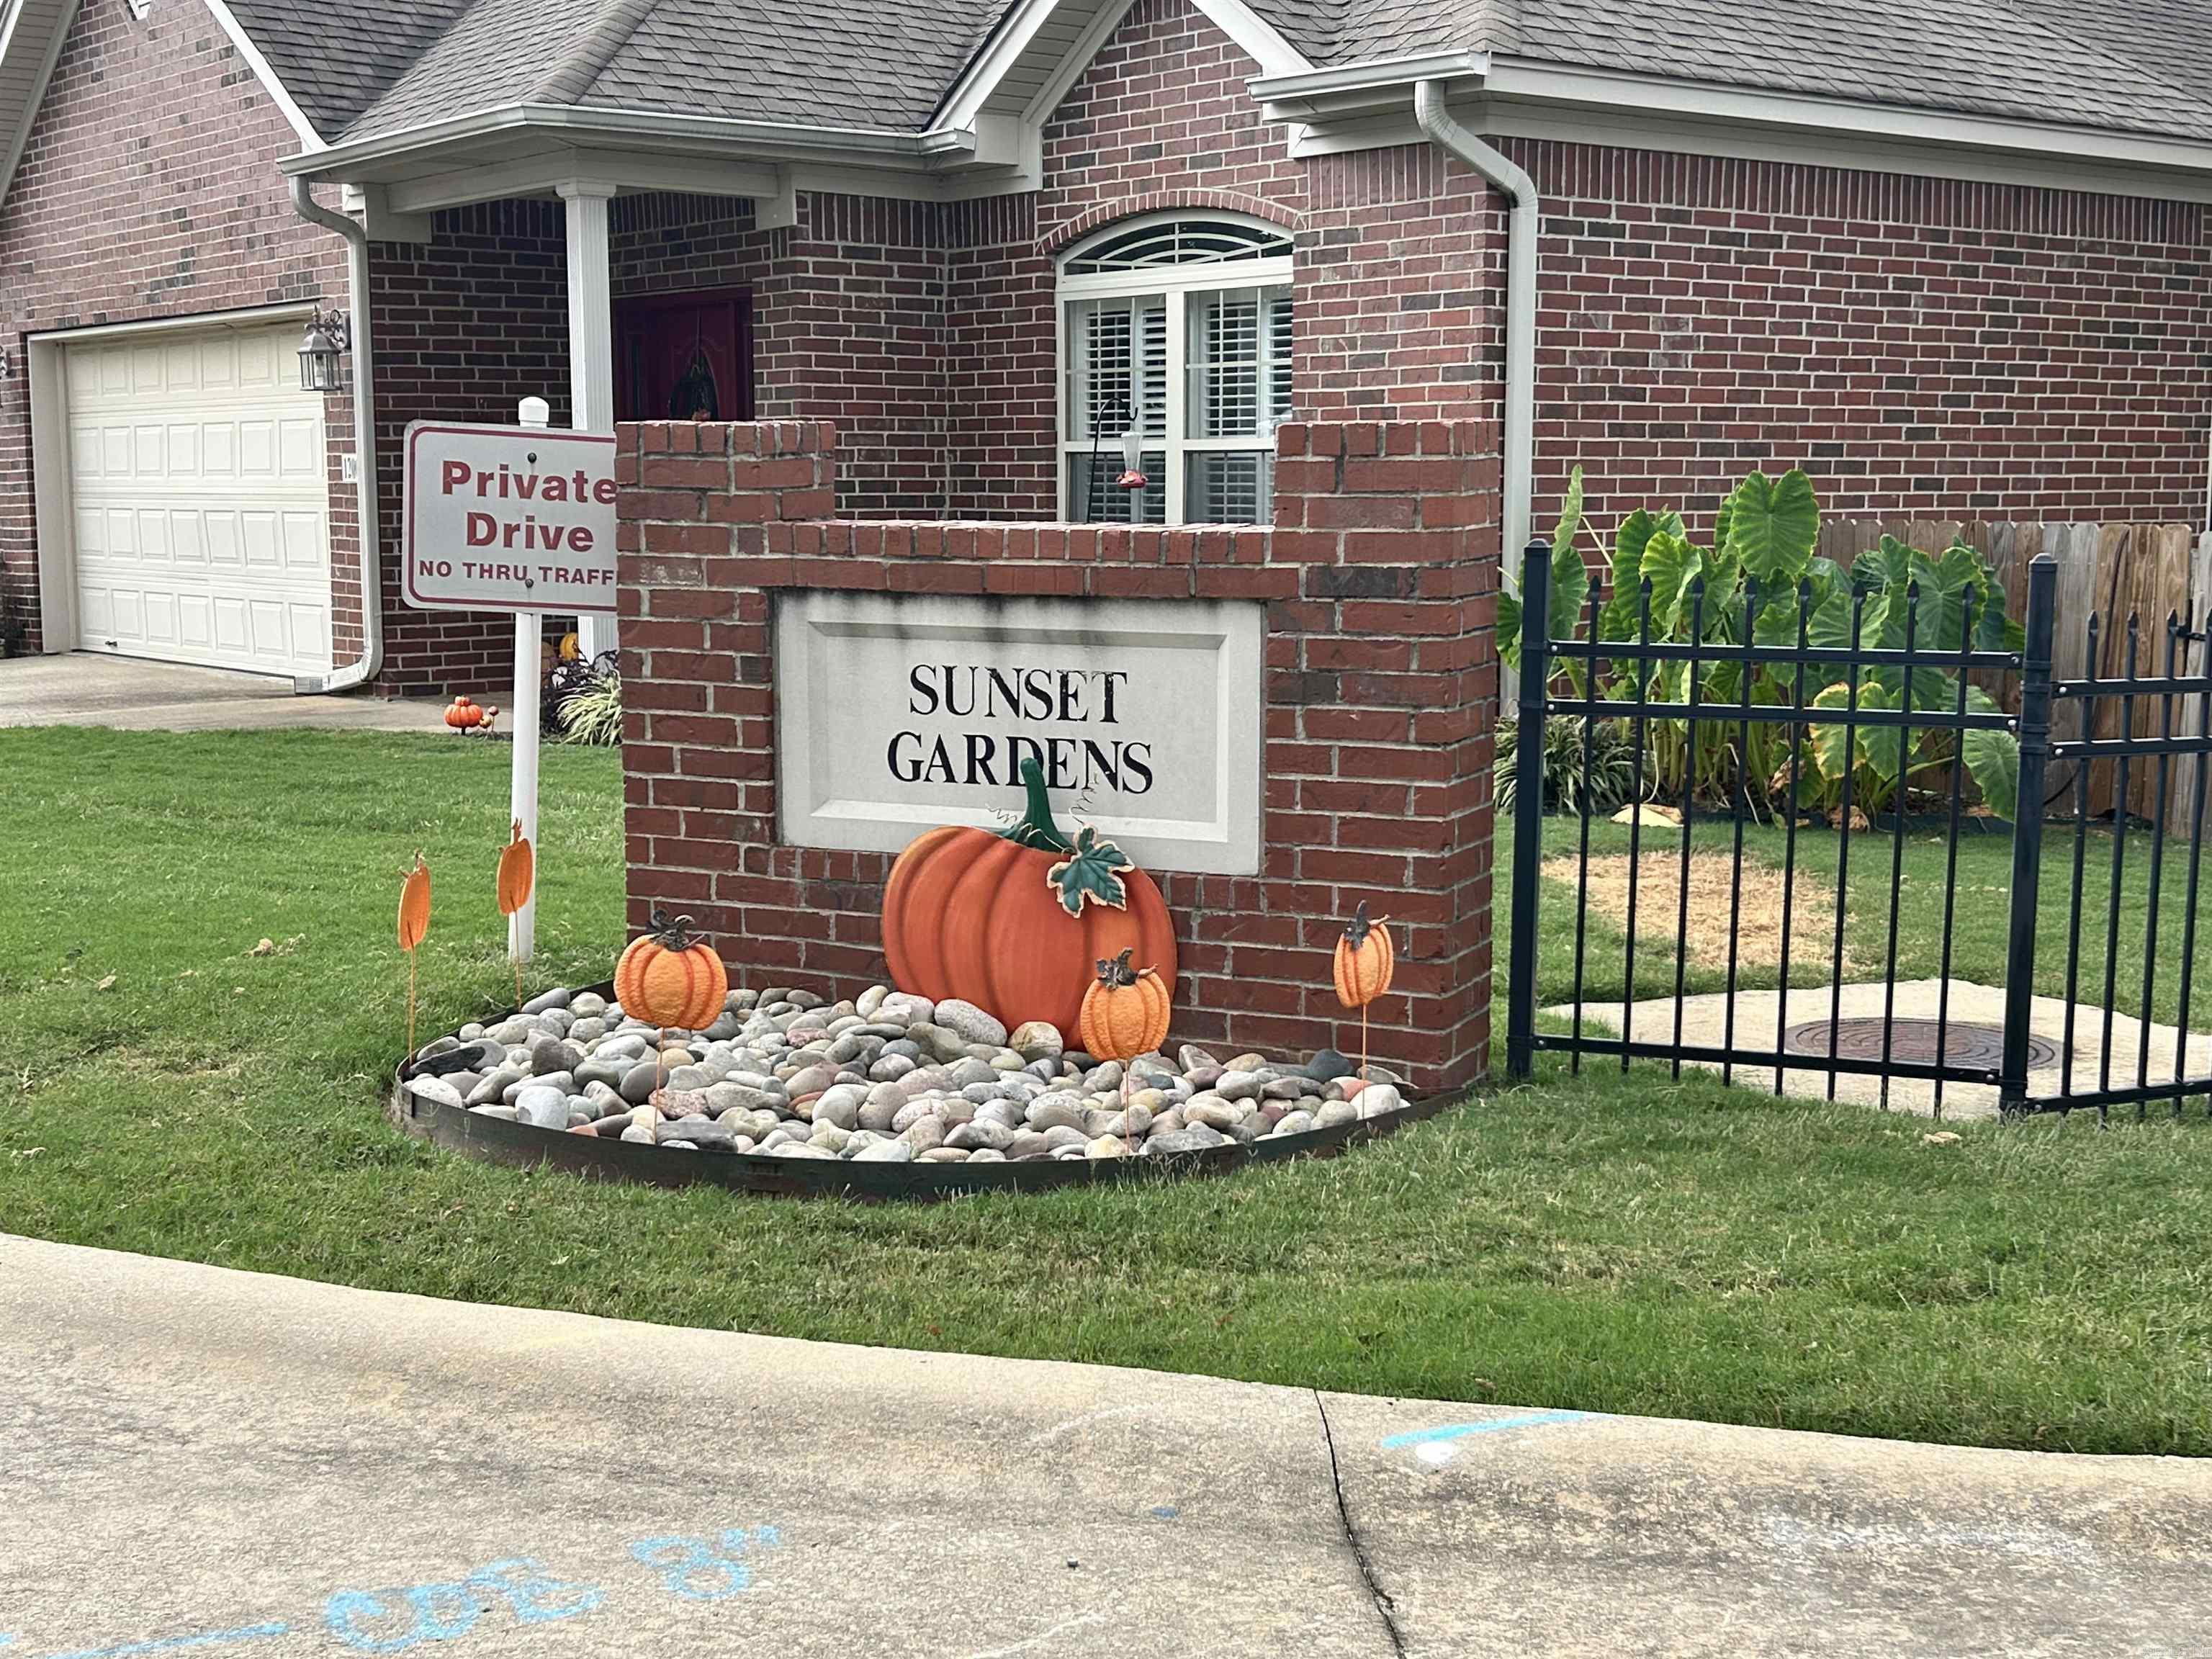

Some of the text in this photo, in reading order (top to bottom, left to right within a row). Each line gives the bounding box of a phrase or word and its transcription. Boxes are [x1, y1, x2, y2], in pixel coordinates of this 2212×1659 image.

[442, 460, 617, 504] Private
[467, 512, 594, 552] Drive
[419, 560, 452, 577] NO
[462, 562, 528, 581] THRU
[910, 664, 1128, 724] SUNSET
[887, 731, 1153, 794] GARDENS
